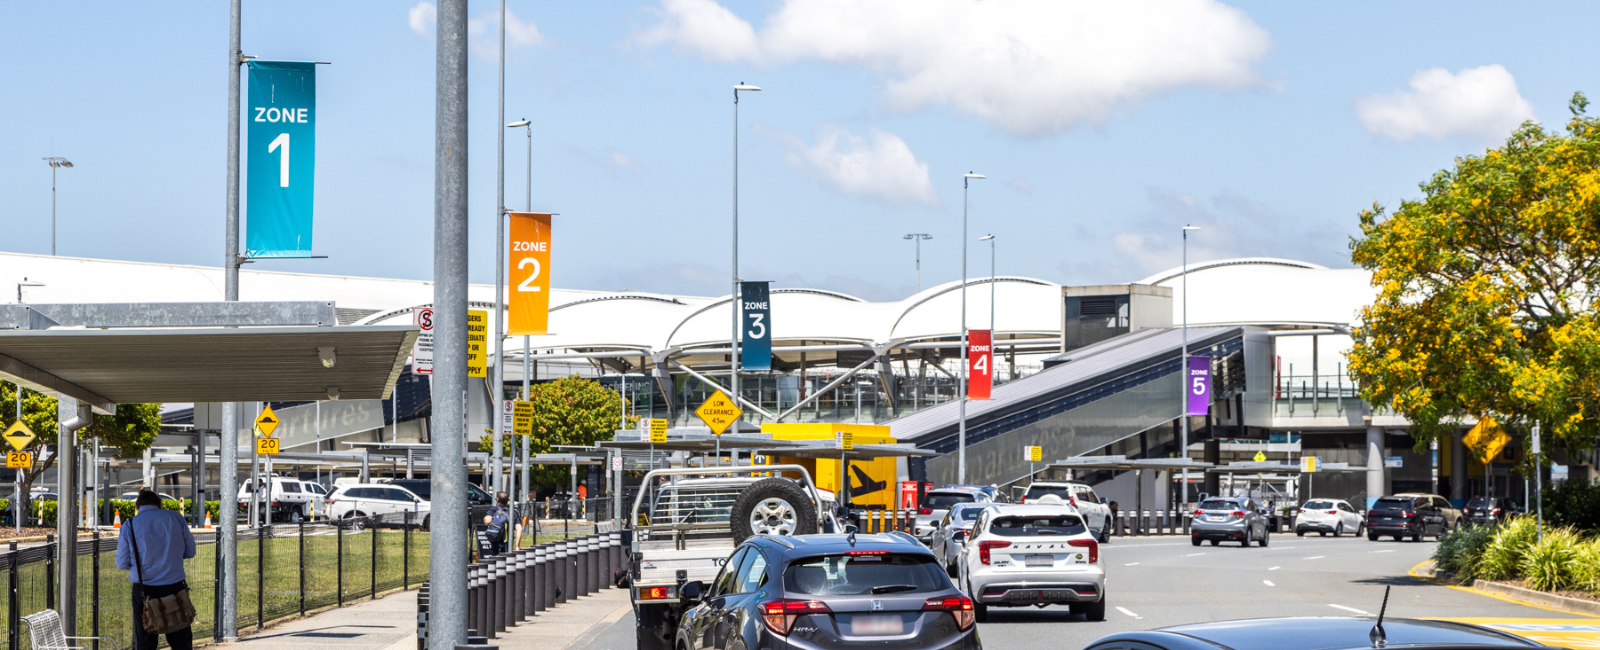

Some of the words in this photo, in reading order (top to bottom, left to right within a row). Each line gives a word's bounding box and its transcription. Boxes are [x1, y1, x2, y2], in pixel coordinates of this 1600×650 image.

[254, 107, 308, 123] ZONE
[268, 133, 290, 187] 1
[513, 241, 547, 252] ZONE
[517, 257, 541, 292] 2
[744, 301, 768, 310] ZONE
[748, 313, 766, 339] 3
[973, 354, 988, 375] 4
[1193, 377, 1206, 395] 5
[261, 440, 275, 448] 20
[12, 454, 27, 462] 20
